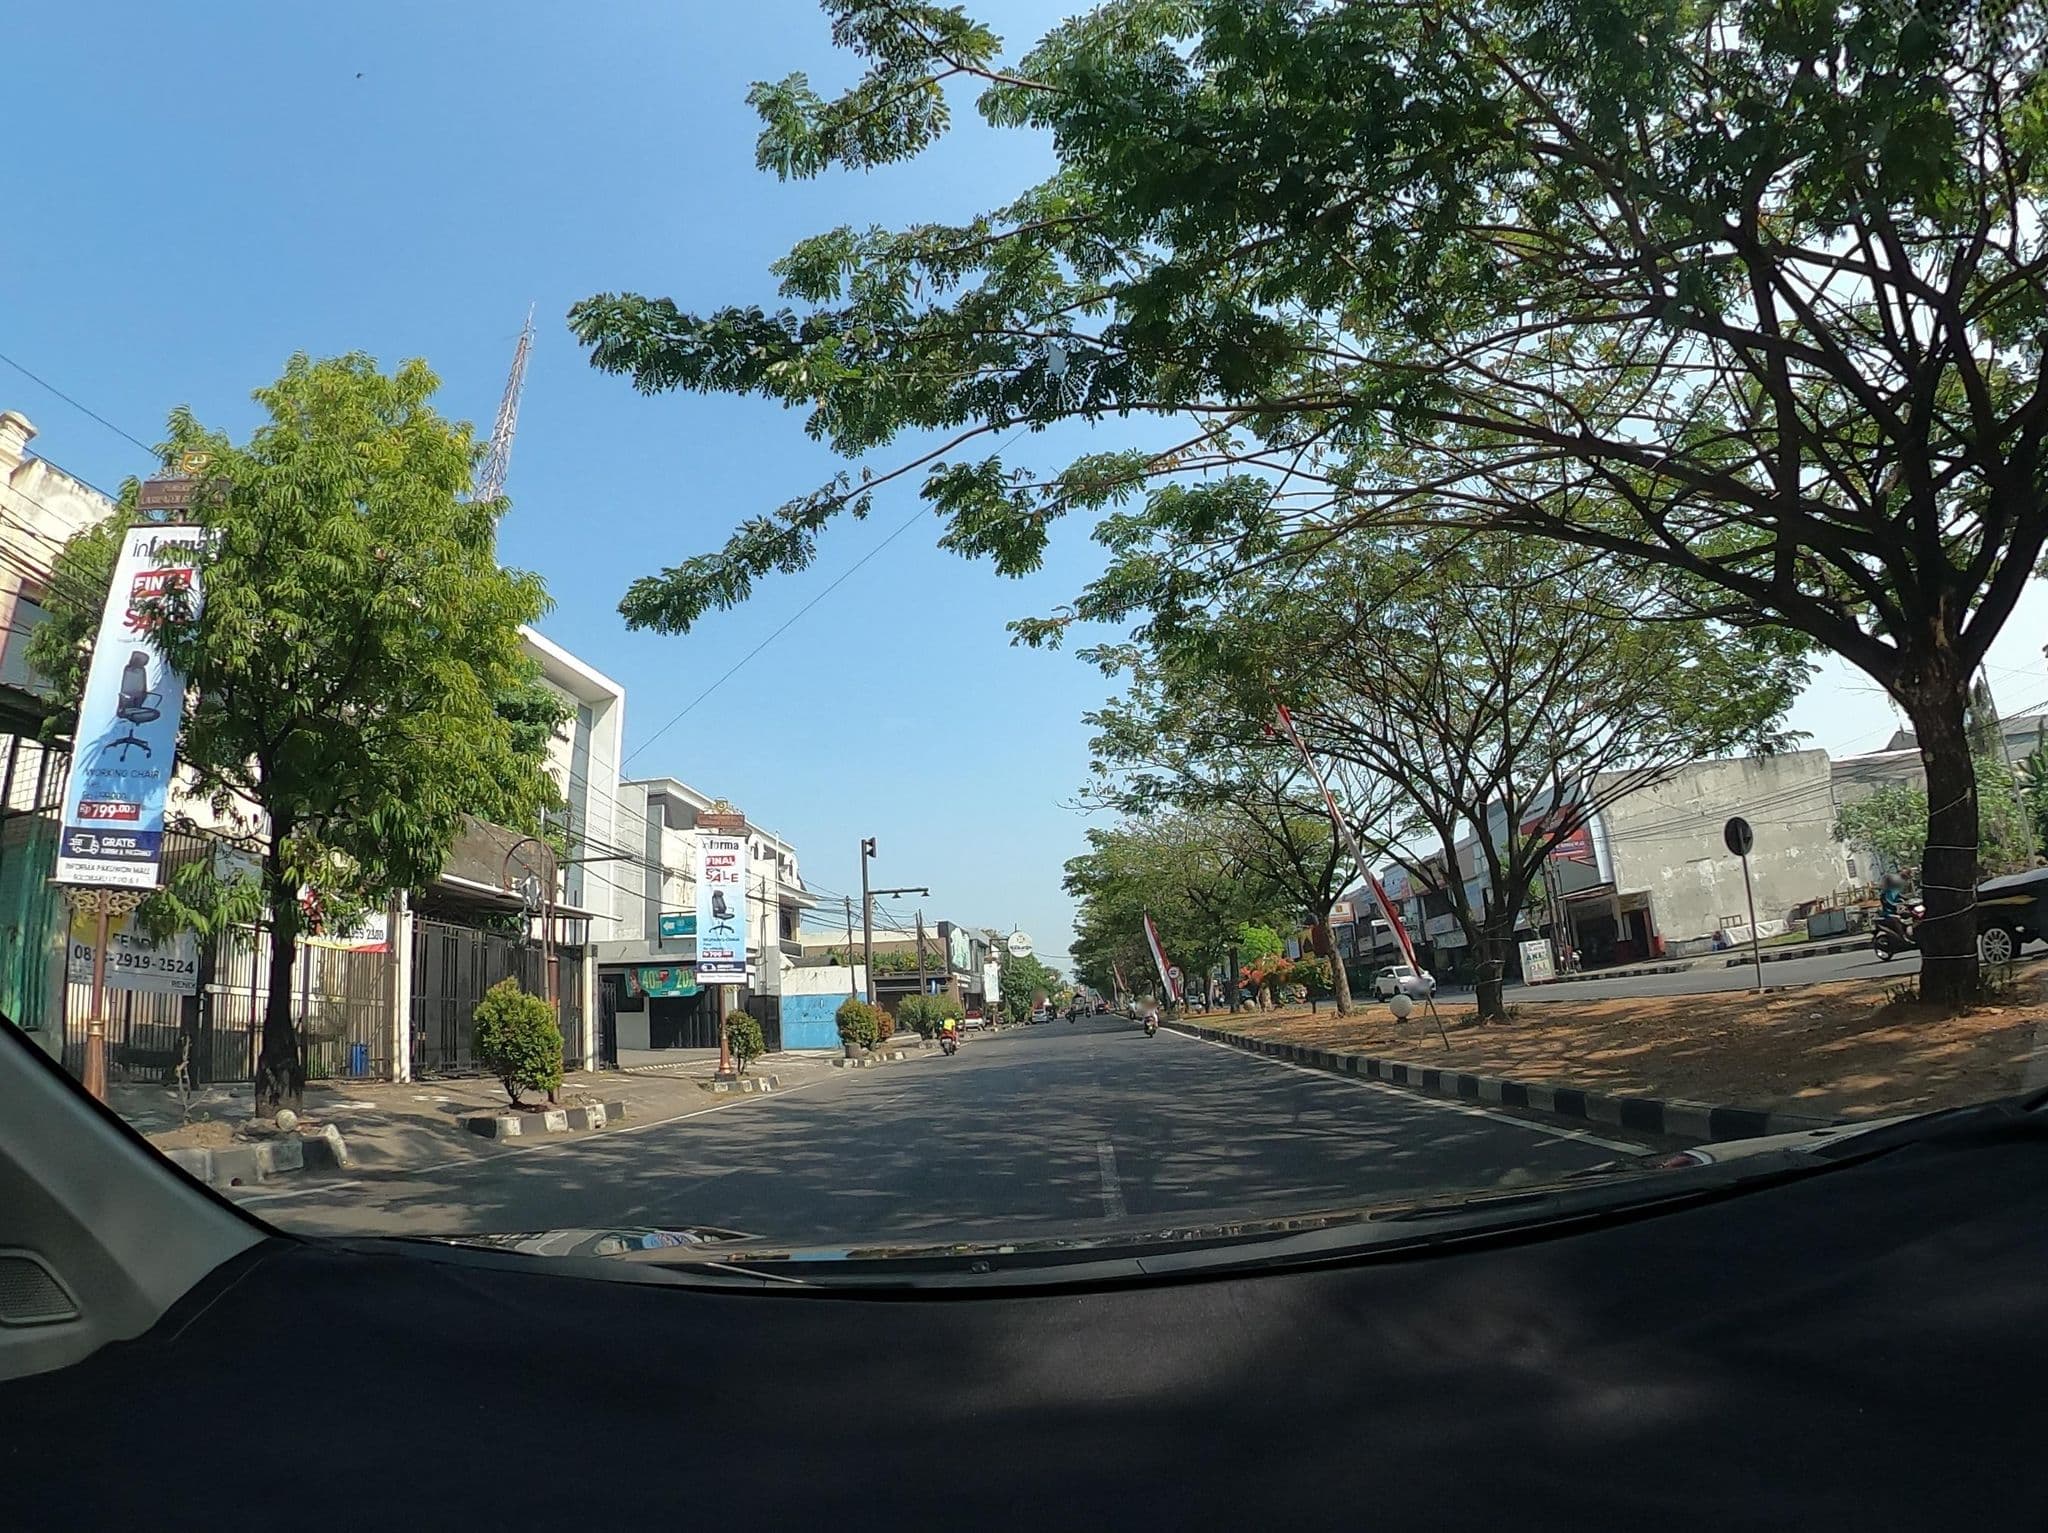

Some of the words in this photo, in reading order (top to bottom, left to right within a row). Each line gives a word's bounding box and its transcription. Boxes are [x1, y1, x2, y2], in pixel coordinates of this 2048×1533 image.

[102, 837, 137, 848] GRATIS
[706, 856, 735, 866] FINAL
[705, 867, 739, 883] SALE
